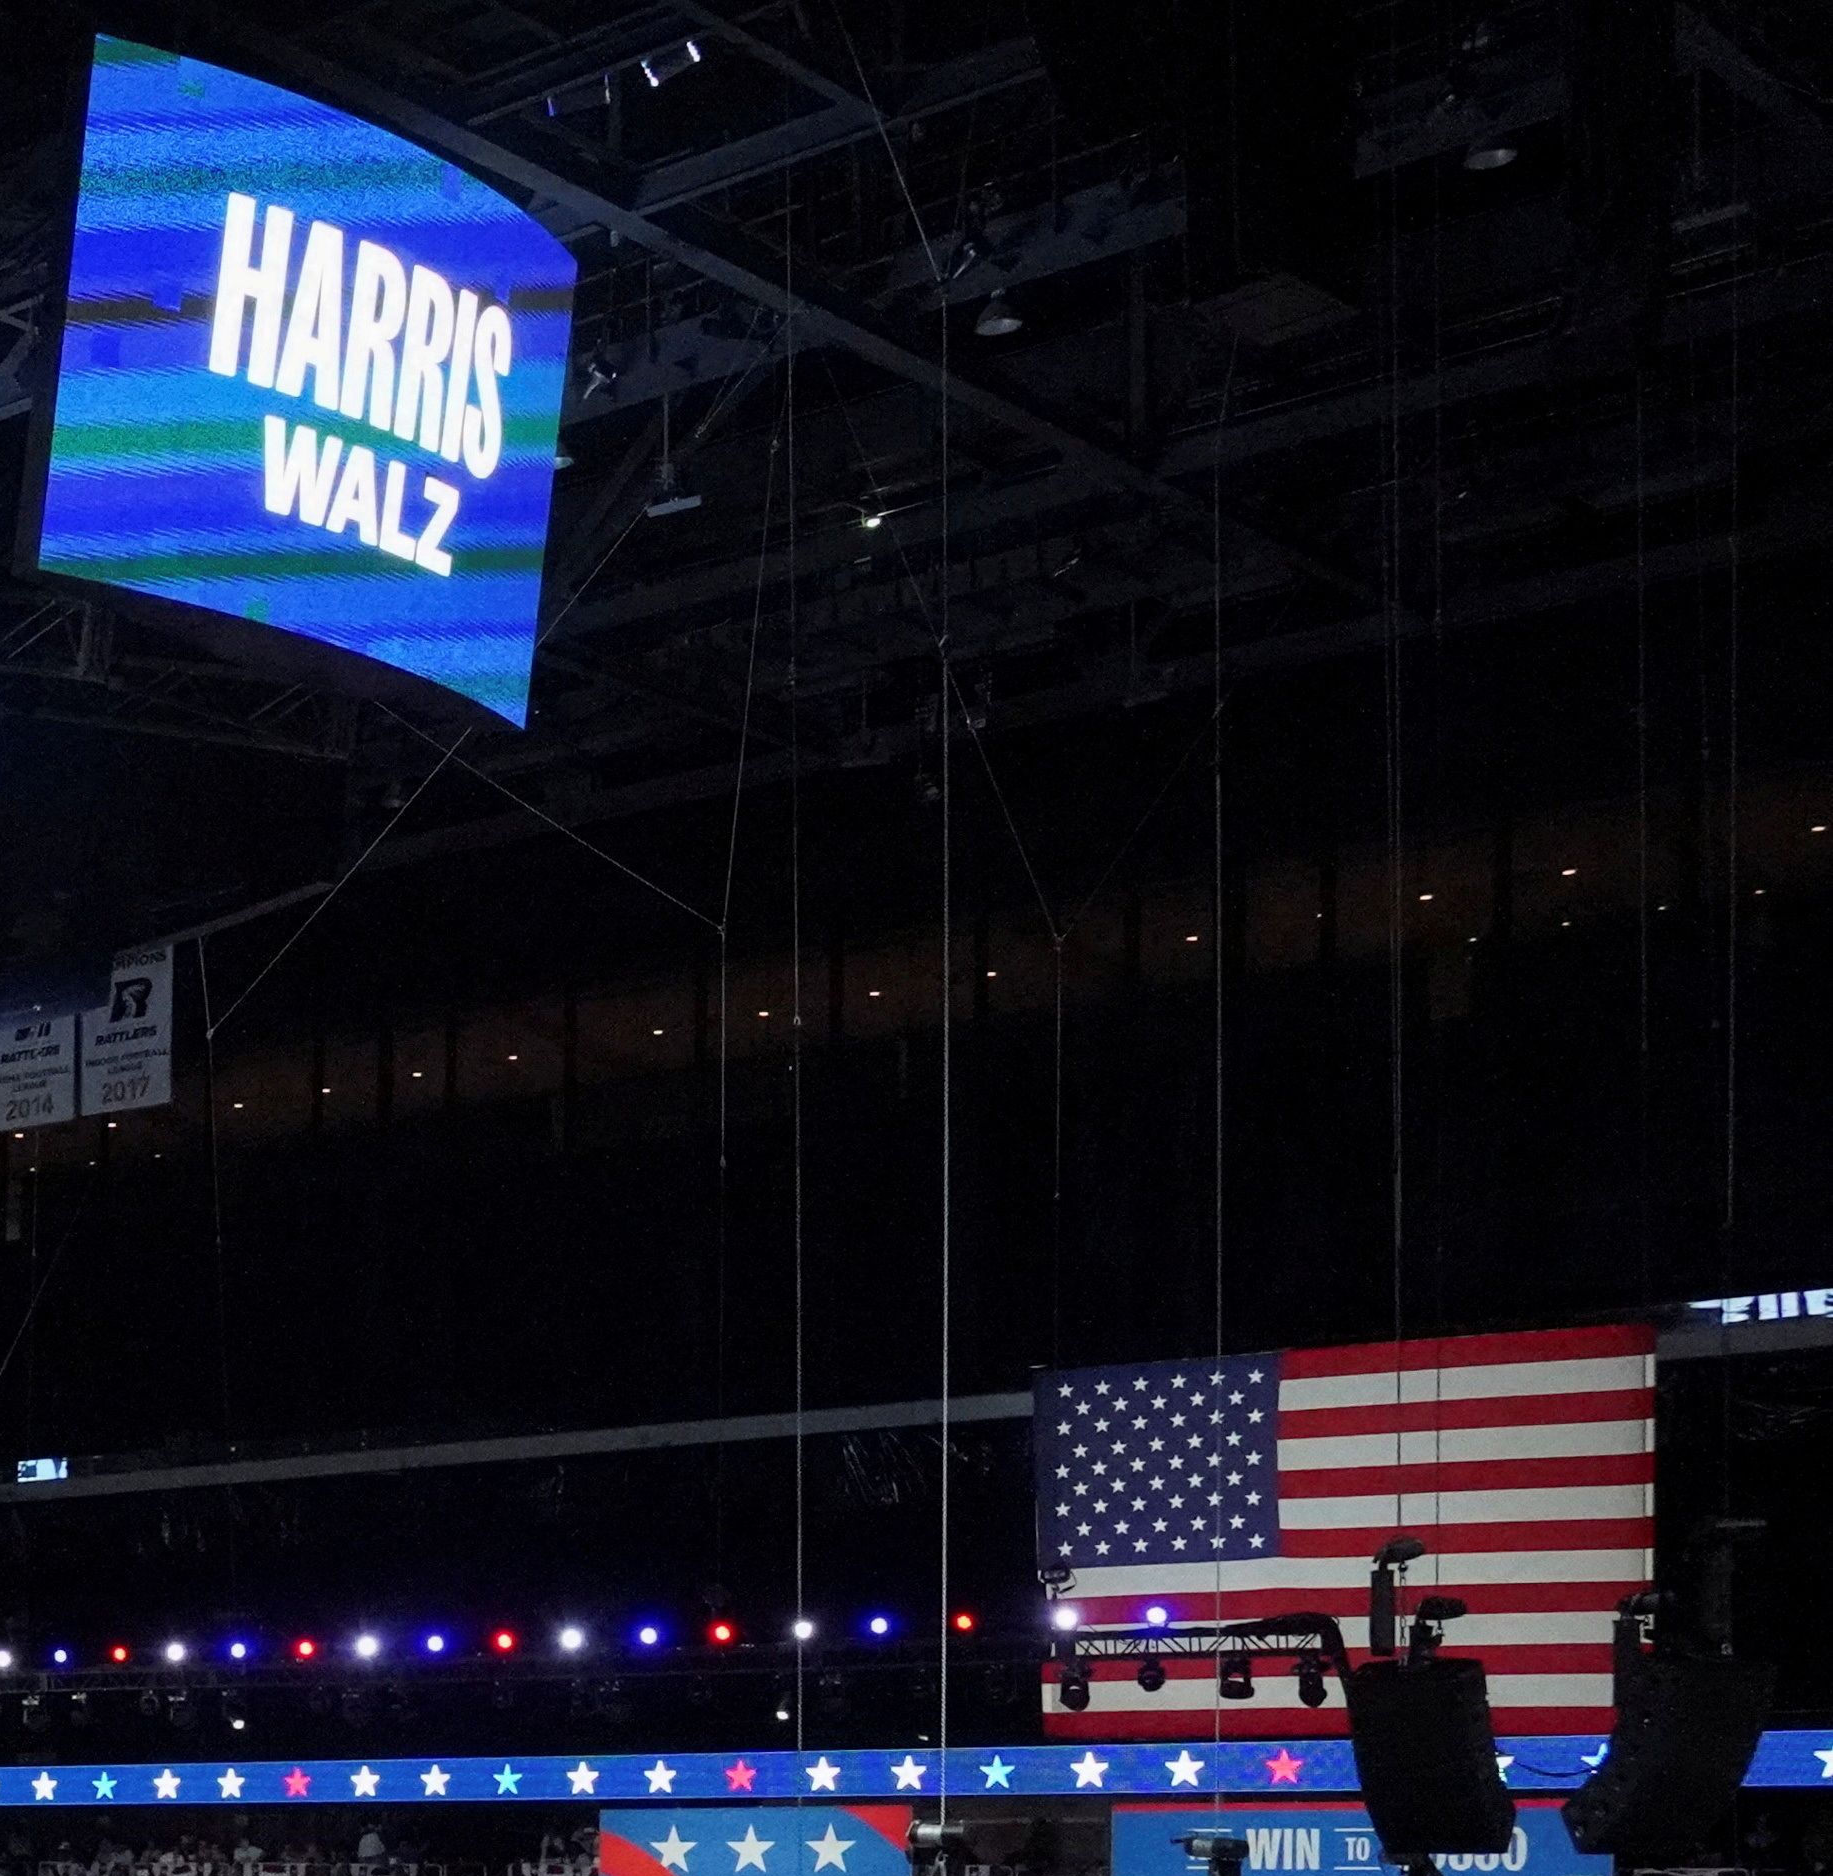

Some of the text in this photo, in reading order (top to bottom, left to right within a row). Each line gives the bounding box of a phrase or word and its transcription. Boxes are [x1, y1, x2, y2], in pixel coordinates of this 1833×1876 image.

[208, 191, 514, 480] HARRIS
[263, 415, 458, 577] WALZ
[95, 1024, 157, 1047] RATTLERS
[5, 1094, 54, 1121] 2014
[101, 1076, 150, 1106] 2017
[1246, 1828, 1370, 1871] WIN TO
